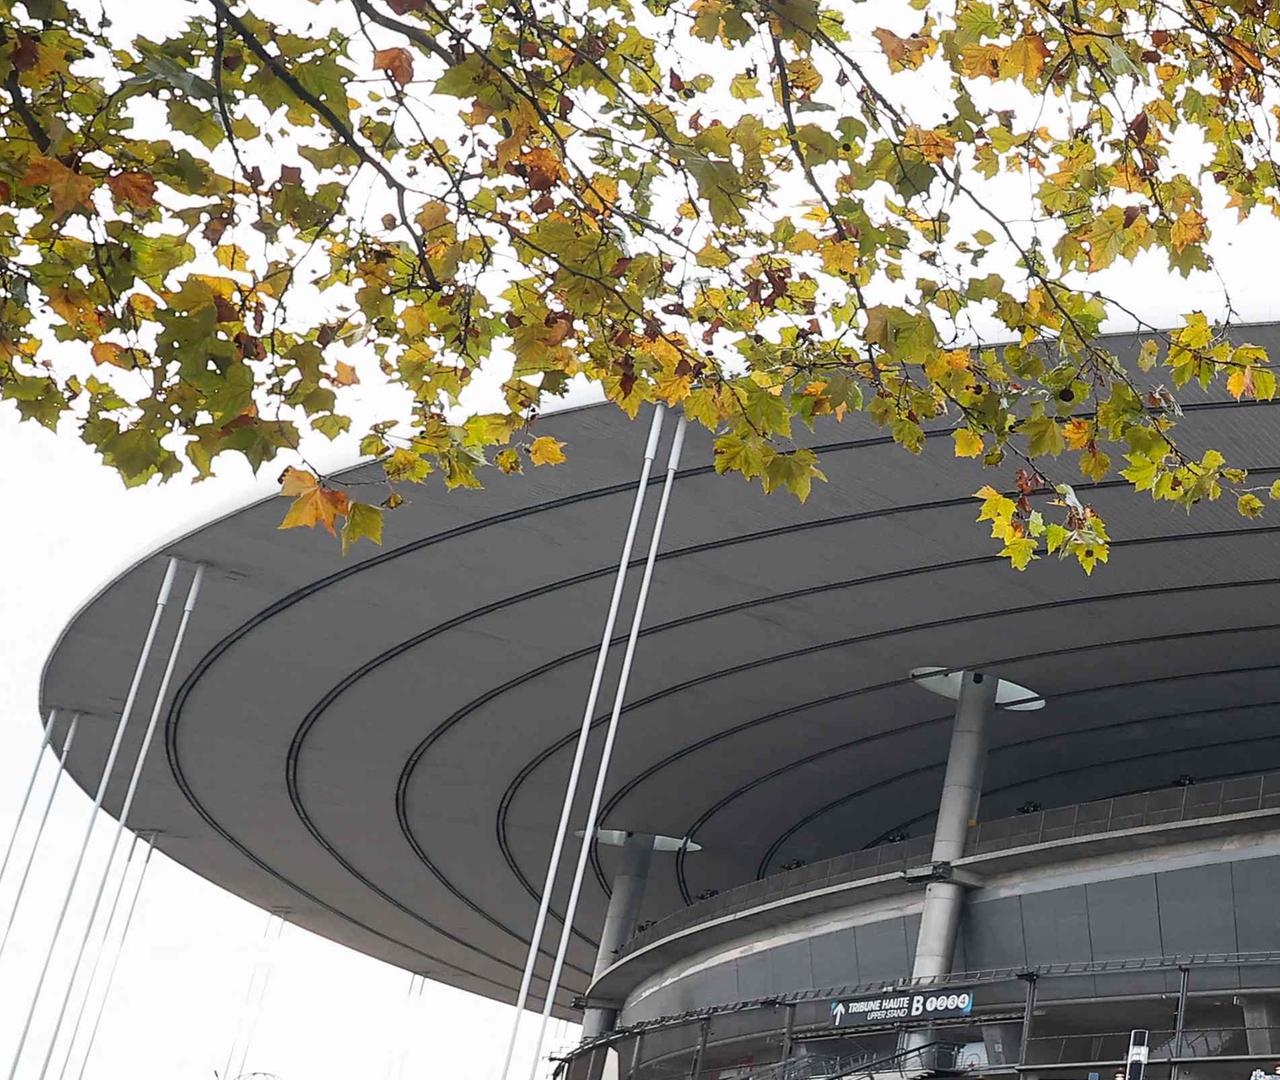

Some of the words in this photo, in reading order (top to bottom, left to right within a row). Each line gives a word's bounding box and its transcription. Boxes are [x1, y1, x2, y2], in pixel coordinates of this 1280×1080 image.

[848, 1000, 881, 1013] TRIBUNE
[882, 997, 910, 1010] HAUTE
[911, 995, 924, 1016] B
[867, 1011, 885, 1020] UPPER
[886, 1008, 908, 1019] STAND
